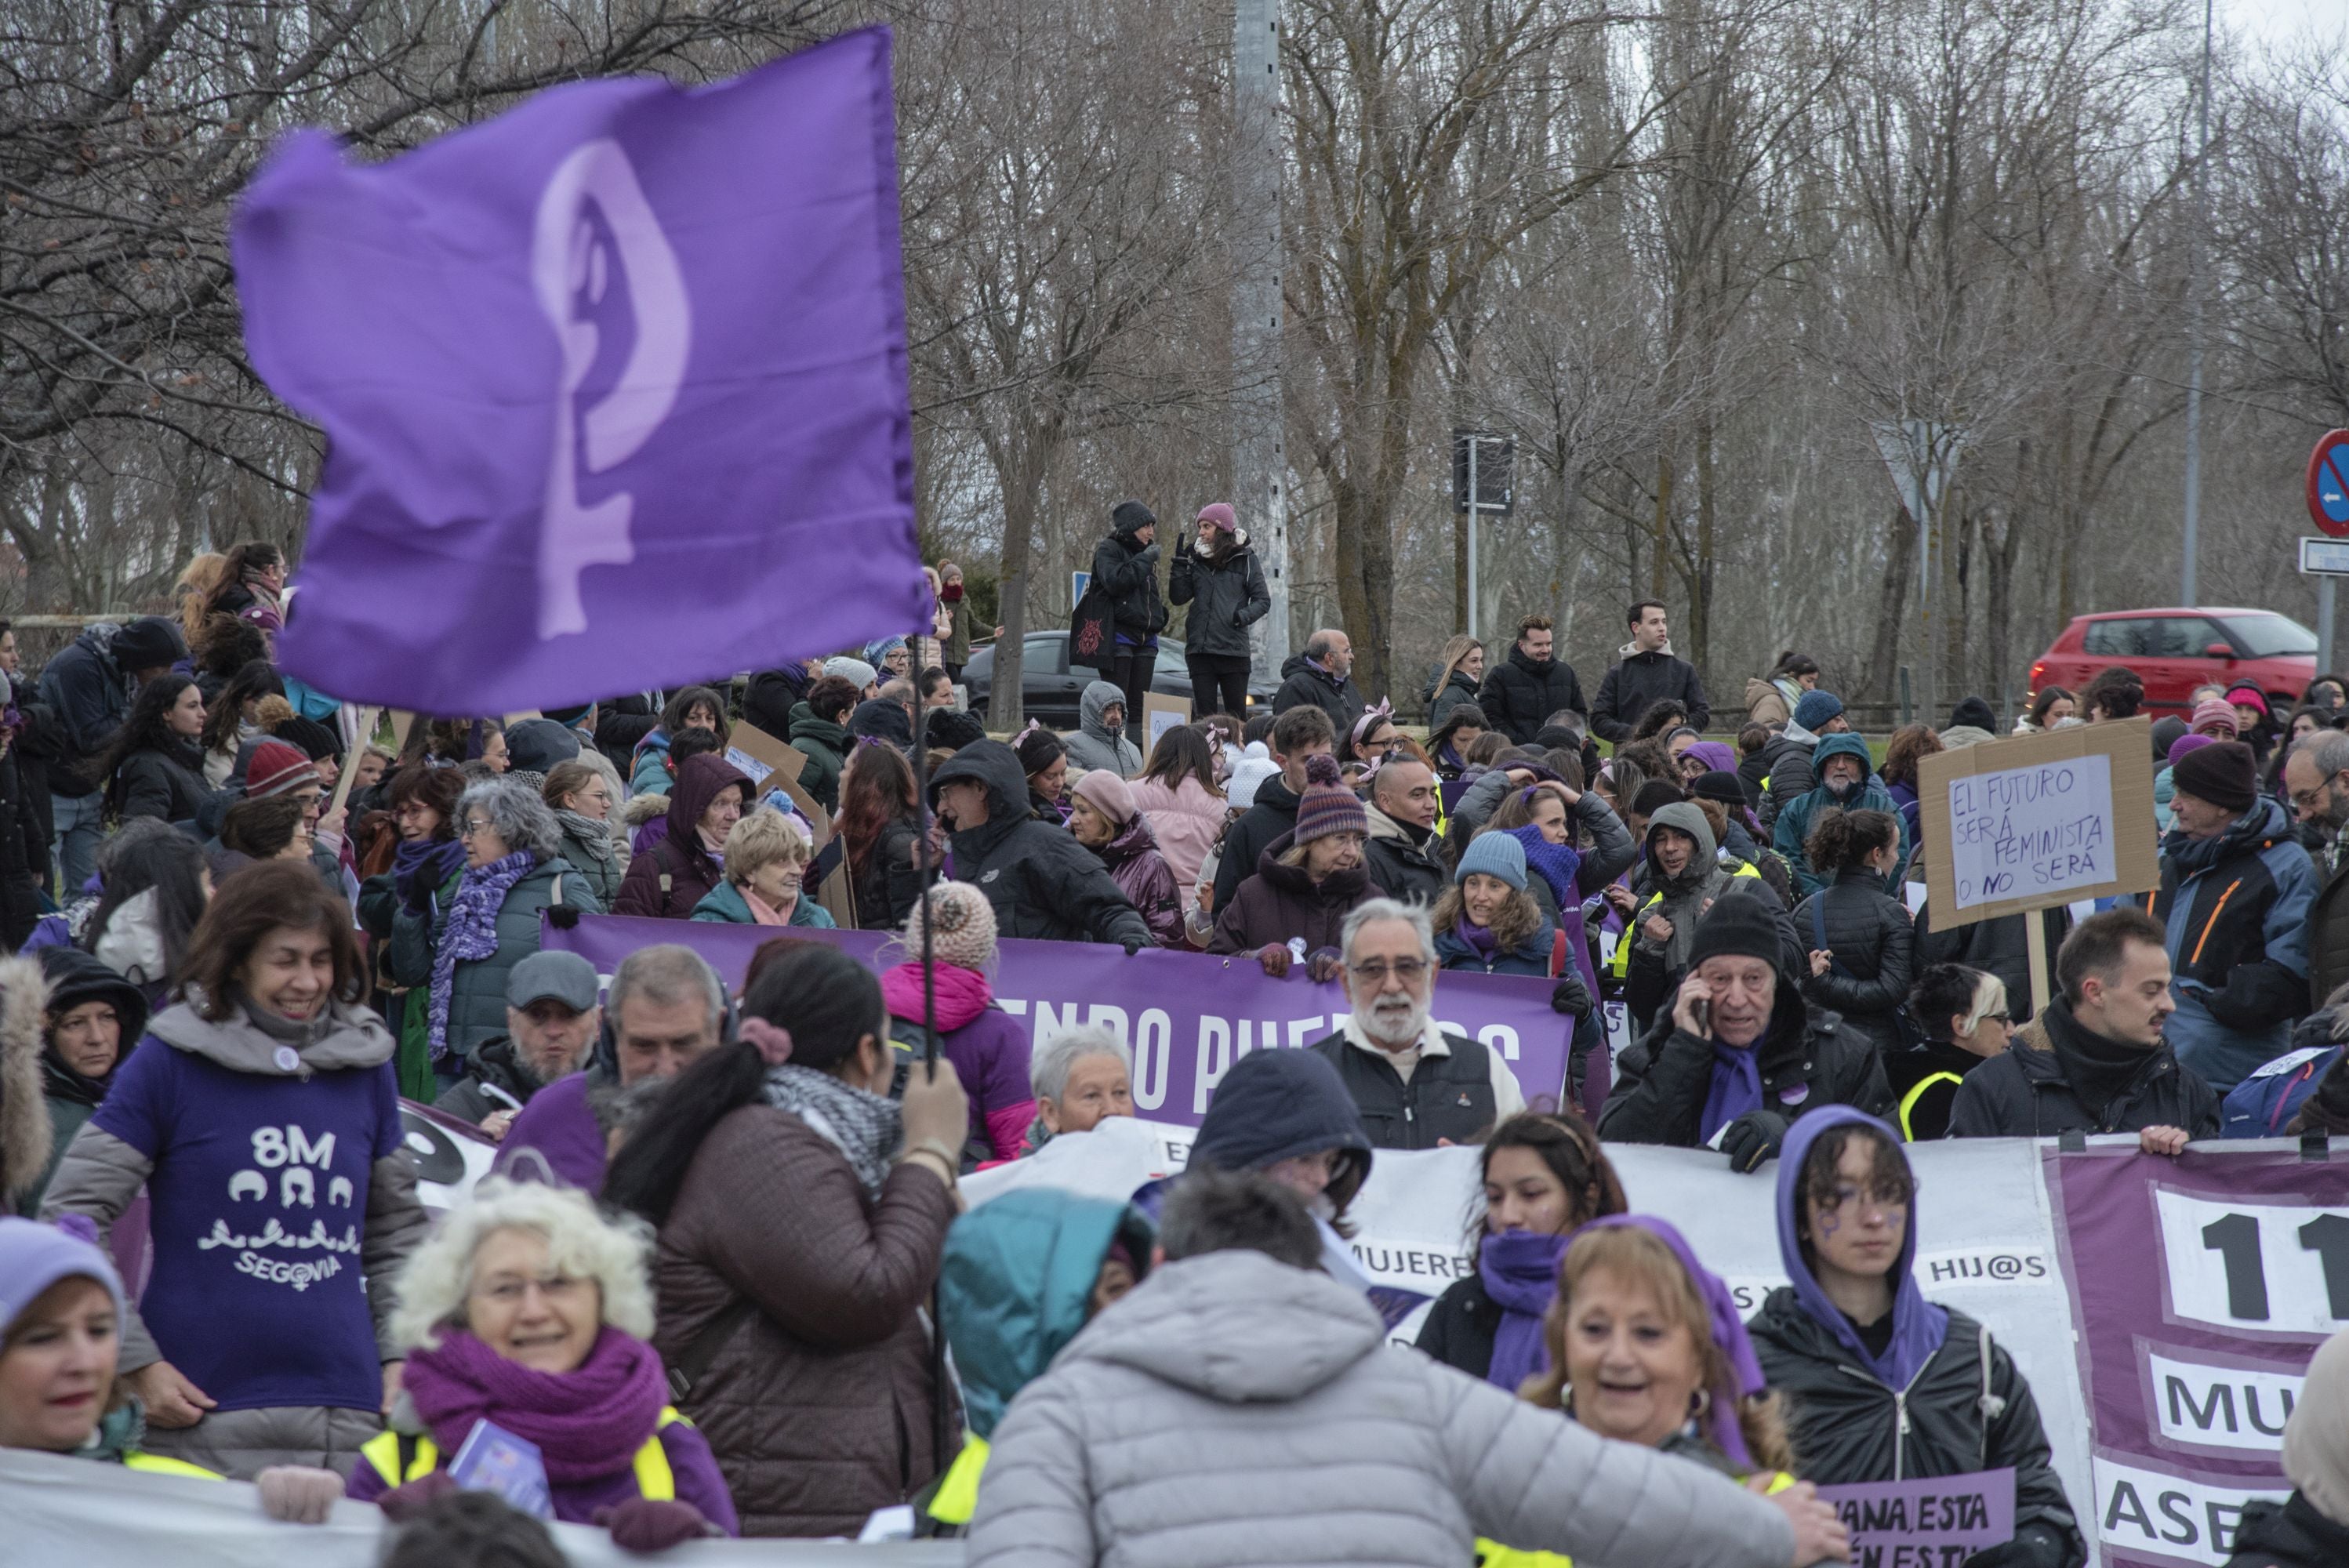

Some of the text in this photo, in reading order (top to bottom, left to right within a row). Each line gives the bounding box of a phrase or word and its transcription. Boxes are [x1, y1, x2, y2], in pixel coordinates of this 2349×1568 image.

[1954, 768, 2075, 817] EL FUTURO
[1956, 806, 2013, 845] SERÁ
[1994, 815, 2103, 866] FEMINISTA
[1959, 844, 2096, 901] O NO SERÁ
[250, 1123, 337, 1171] 8M
[234, 1250, 343, 1292] SEGOVIA
[1930, 1254, 2046, 1282] HIJ@S
[1918, 1493, 1988, 1531] ESTA
